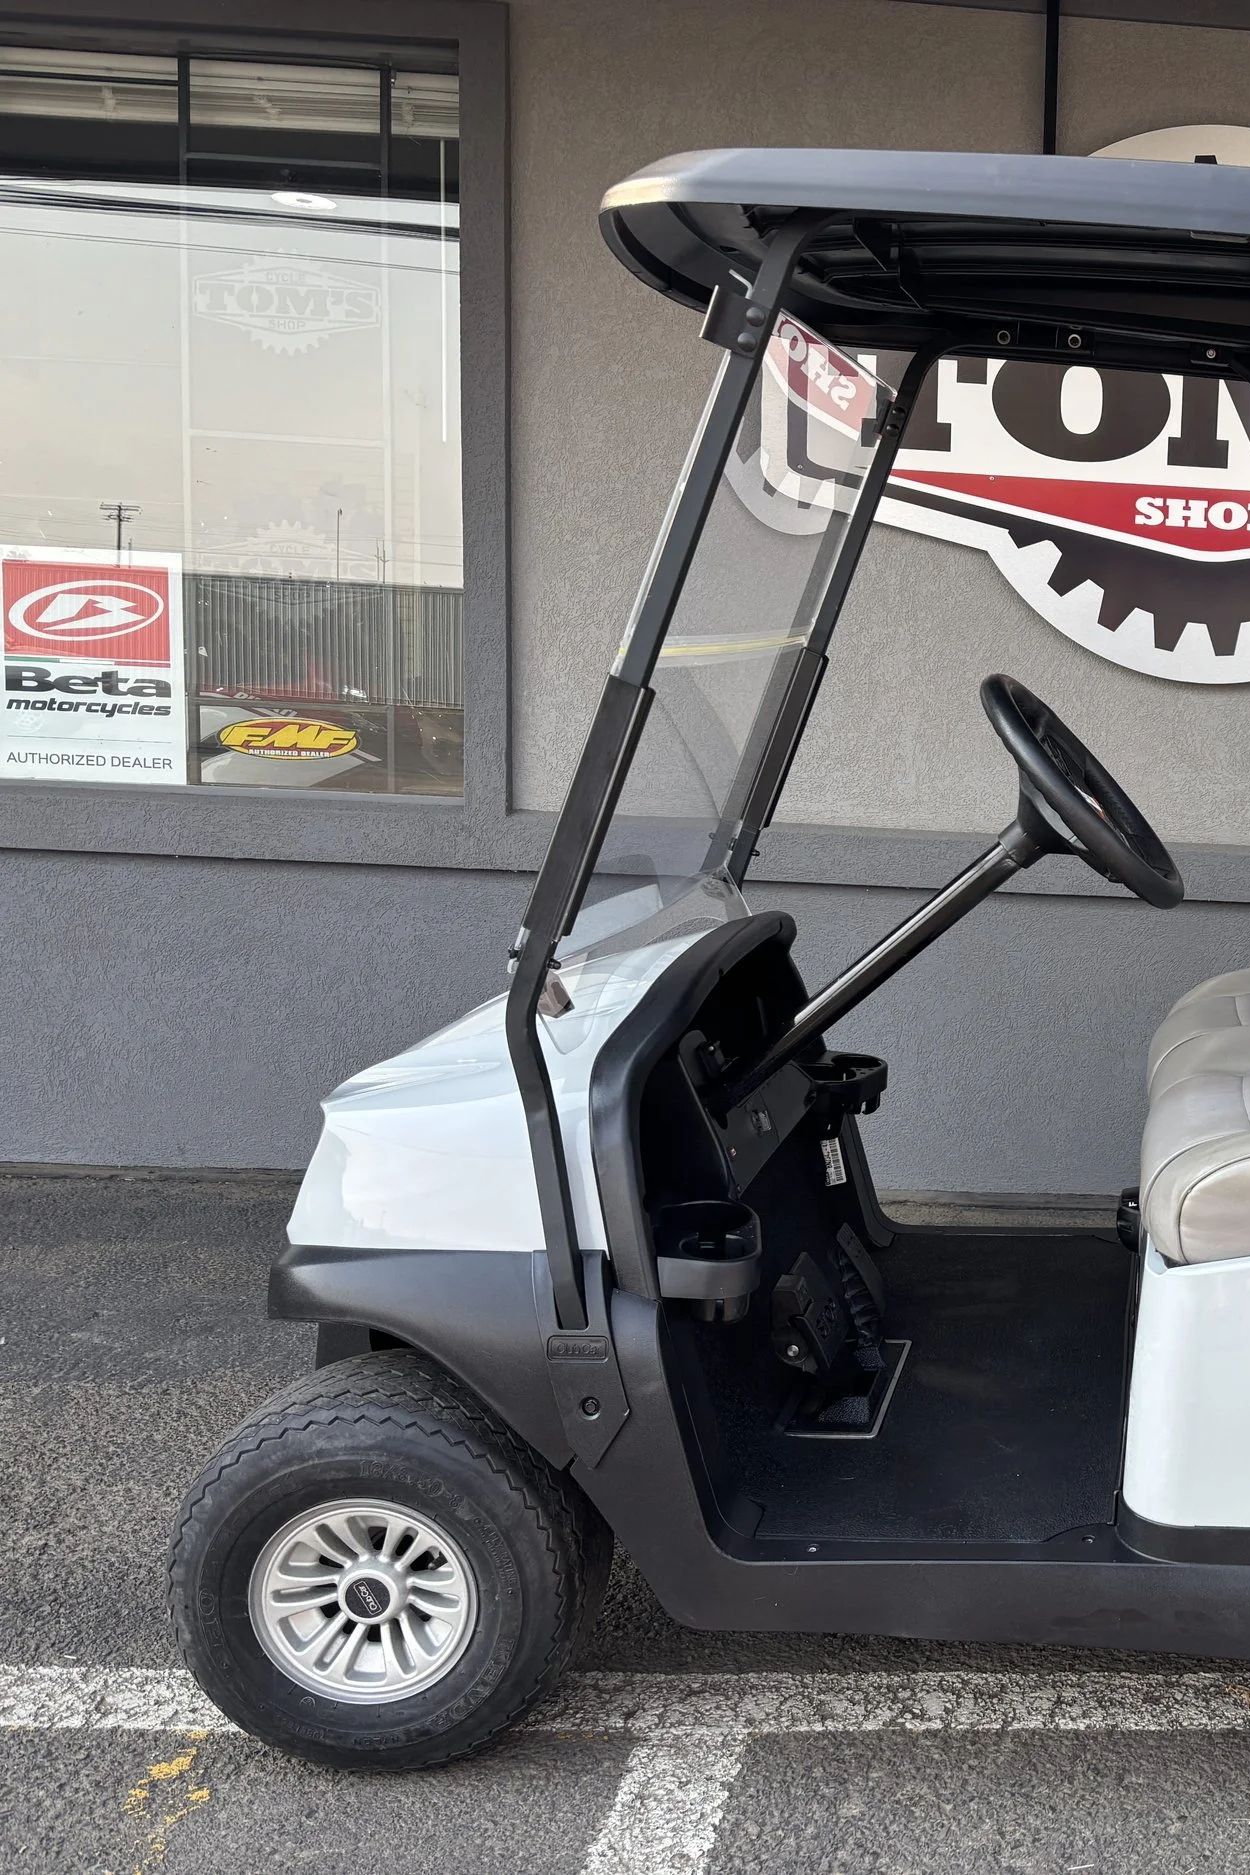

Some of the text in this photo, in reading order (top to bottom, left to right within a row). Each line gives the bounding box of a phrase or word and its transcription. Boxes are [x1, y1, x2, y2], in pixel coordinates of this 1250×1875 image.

[198, 282, 375, 320] TOM'S
[268, 319, 306, 331] SHOP
[5, 665, 172, 698] Beta
[6, 697, 172, 717] motorcycles
[222, 724, 356, 749] FMF
[7, 752, 173, 770] AUTHORIZED DEALER
[248, 748, 331, 758] AUTHORIZED DEALER
